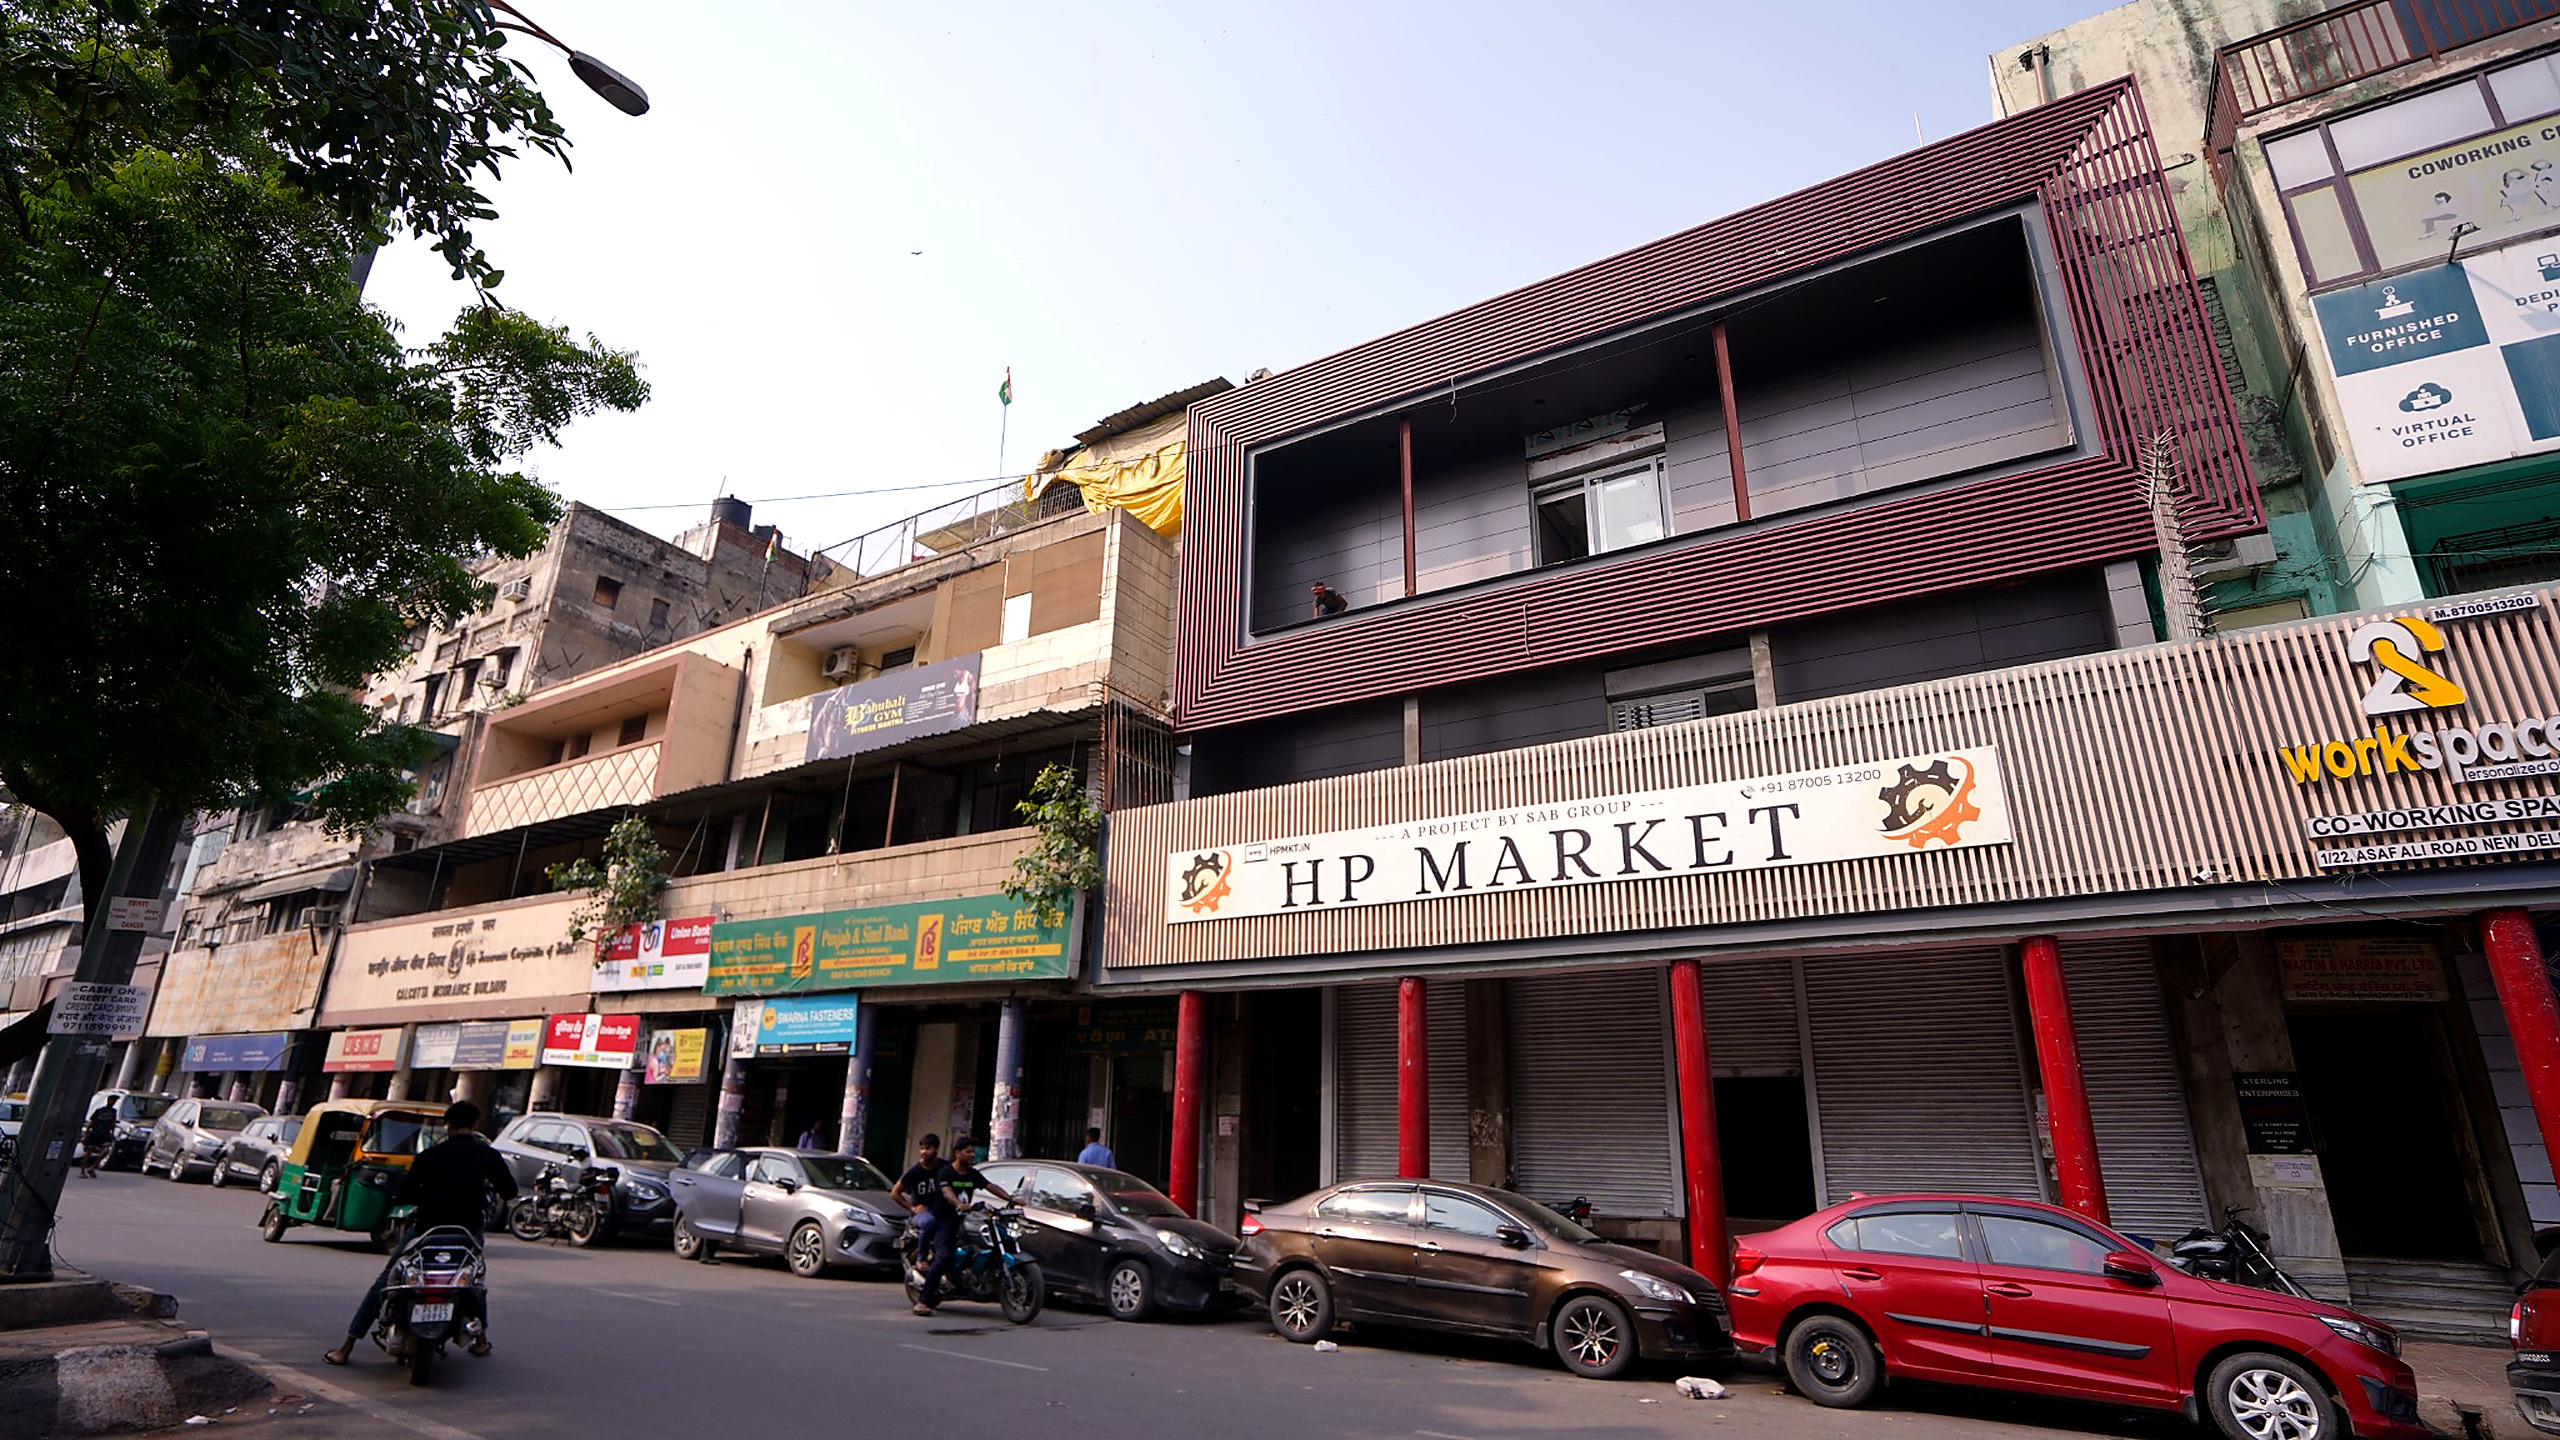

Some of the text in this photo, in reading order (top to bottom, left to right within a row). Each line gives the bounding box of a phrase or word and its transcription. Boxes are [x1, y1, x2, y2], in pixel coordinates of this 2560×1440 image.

[2408, 135, 2532, 179] COWORKING
[2346, 312, 2459, 347] FURNISHED
[2370, 329, 2442, 353] OFFICE
[2391, 413, 2476, 436] VIRTUAL
[2401, 426, 2474, 448] OFFICE
[873, 708, 903, 723] GYM
[2548, 760, 2560, 772] O
[1759, 768, 1882, 794] +91 87005 13200
[1418, 816, 1491, 838] PROJECT
[1498, 812, 1520, 828] BY
[1526, 808, 1561, 824] SAB
[1566, 800, 1632, 819] GROUP
[2312, 797, 2560, 836] CO-WORKING SPA
[1280, 803, 1801, 908] HP MARKET
[2356, 847, 2398, 863] ASAF
[2400, 844, 2428, 859] ALI
[2431, 840, 2478, 857] ROAD
[2482, 835, 2520, 852] NEW
[670, 924, 711, 939] Union Bank
[821, 922, 909, 950] Punjab & Sind Bank
[2282, 959, 2325, 971] MARTIN
[2385, 959, 2411, 971] PVT.
[2412, 958, 2438, 971] LTD.
[79, 985, 137, 995] CASH ON
[396, 985, 428, 1000] CALCUTTA
[432, 982, 472, 998] INSURANCE
[65, 1002, 93, 1011] CREDIT
[93, 1002, 114, 1012] CARD
[73, 994, 137, 1004] CREDIT CARD
[777, 1008, 854, 1024] SWARNA FASTENERS
[62, 1022, 132, 1032] 9711899991
[599, 1025, 632, 1035] Union Bank
[344, 1037, 379, 1053] USHA
[2239, 1089, 2300, 1097] ENTERPRISES
